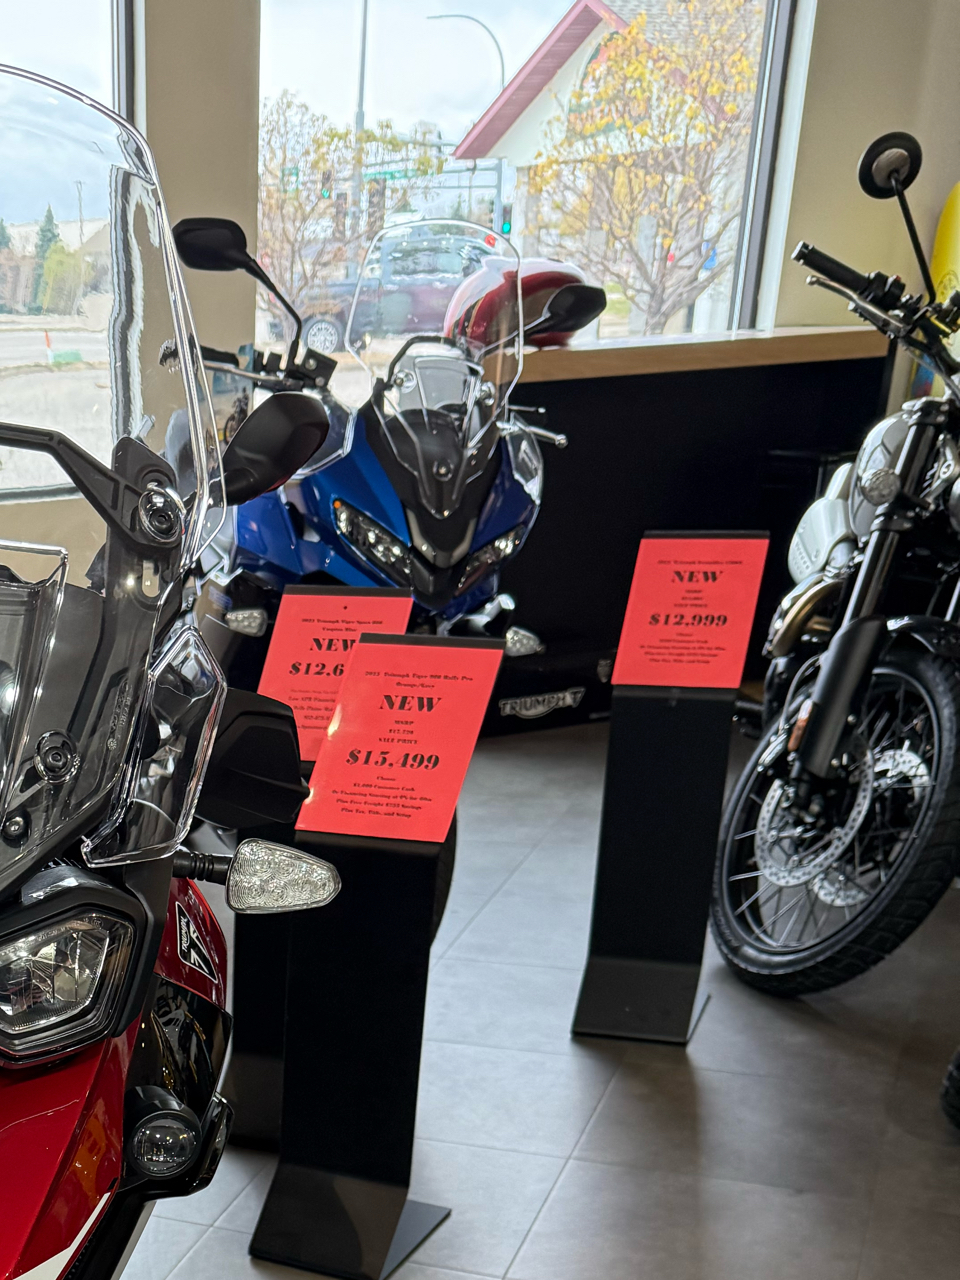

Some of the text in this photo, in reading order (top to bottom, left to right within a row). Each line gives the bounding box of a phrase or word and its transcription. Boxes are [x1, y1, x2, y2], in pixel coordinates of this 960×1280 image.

[671, 570, 723, 583] NEW
[648, 613, 728, 627] $12,999
[288, 661, 345, 677] $12,6
[379, 695, 442, 712] NEW
[346, 748, 440, 770] $15,499
